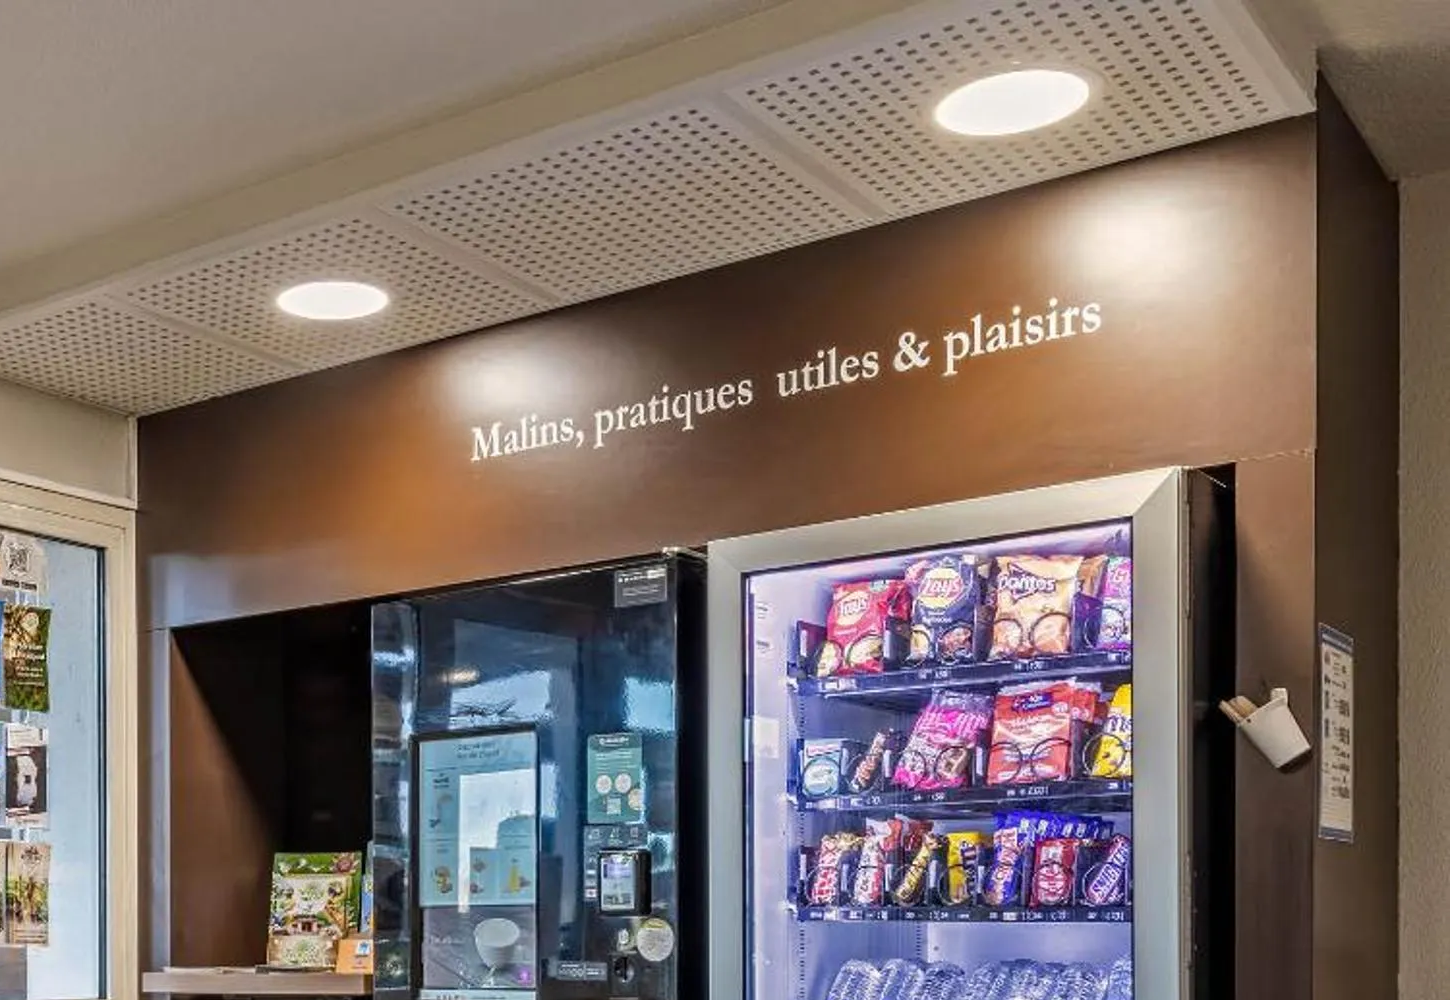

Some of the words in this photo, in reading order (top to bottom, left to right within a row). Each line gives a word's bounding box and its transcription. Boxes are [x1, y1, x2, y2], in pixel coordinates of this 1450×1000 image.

[470, 412, 585, 462] Malins,
[593, 373, 753, 448] pratiques
[776, 347, 881, 399] utiles
[892, 331, 931, 373] &
[941, 296, 1103, 377] plaisirs
[998, 573, 1056, 592] Doritos
